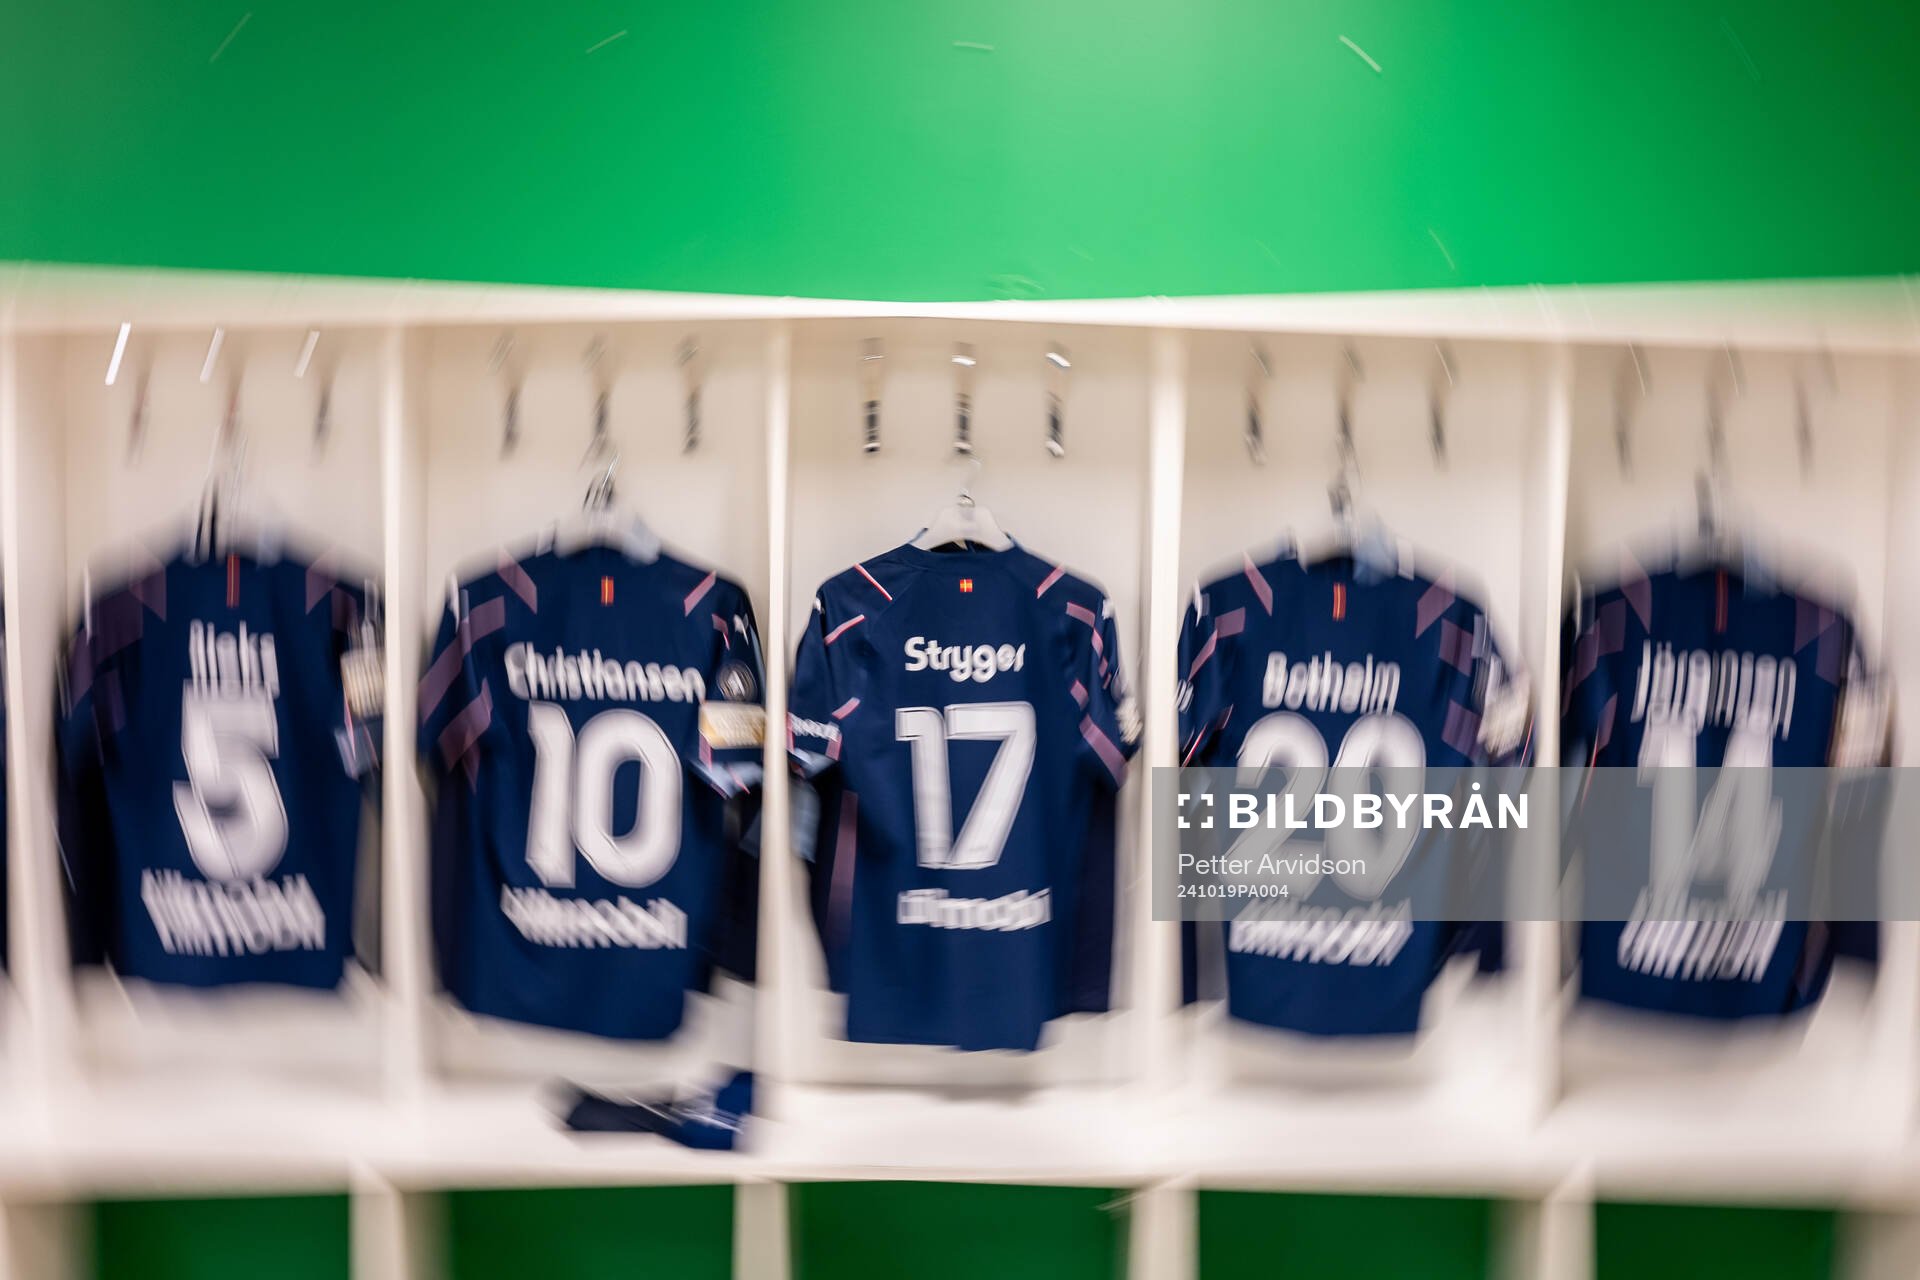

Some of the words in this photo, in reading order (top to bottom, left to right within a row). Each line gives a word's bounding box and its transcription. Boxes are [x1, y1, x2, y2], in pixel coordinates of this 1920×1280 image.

[904, 636, 1026, 683] Stryger
[172, 680, 289, 882] 5
[525, 700, 683, 889] 10
[895, 701, 1037, 870] 17
[1219, 710, 1426, 901] 20
